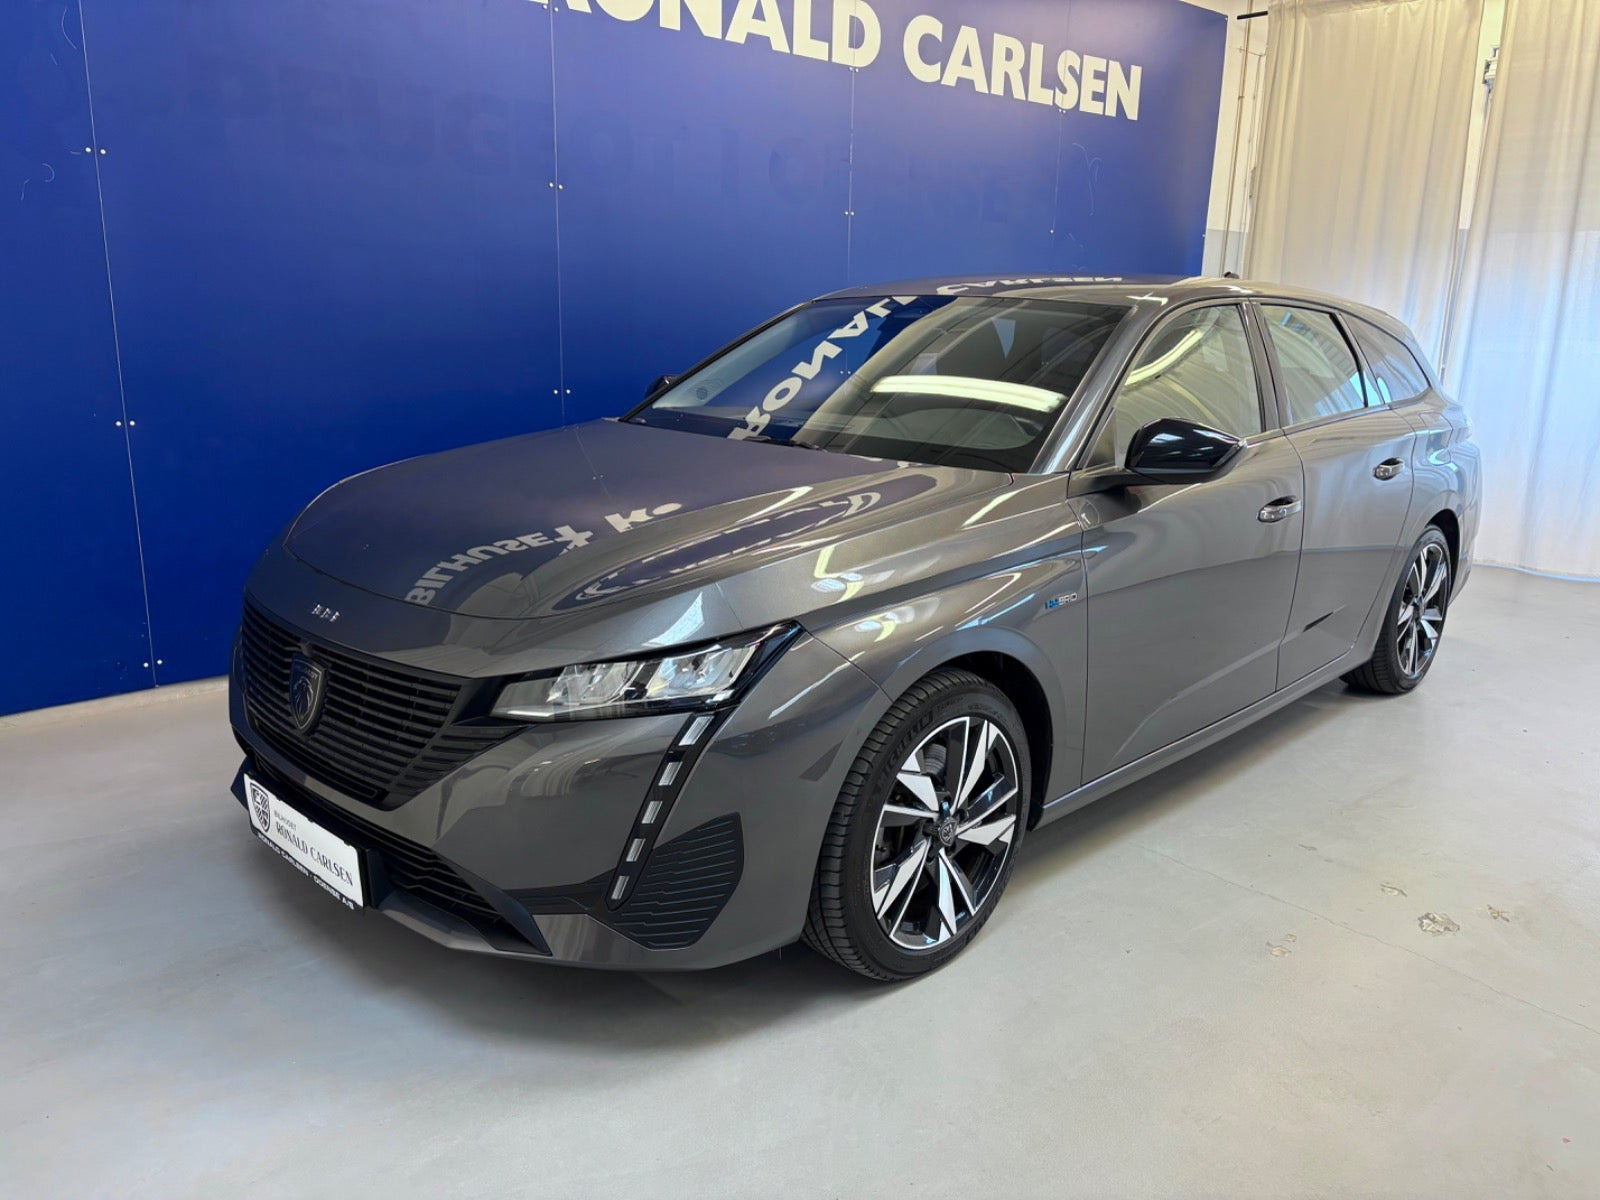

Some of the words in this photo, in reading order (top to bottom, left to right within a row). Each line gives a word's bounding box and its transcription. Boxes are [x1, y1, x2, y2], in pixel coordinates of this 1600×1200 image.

[903, 14, 1142, 121] CARLSEN
[276, 821, 308, 855] RONALD
[310, 846, 353, 887] CARLSEN
